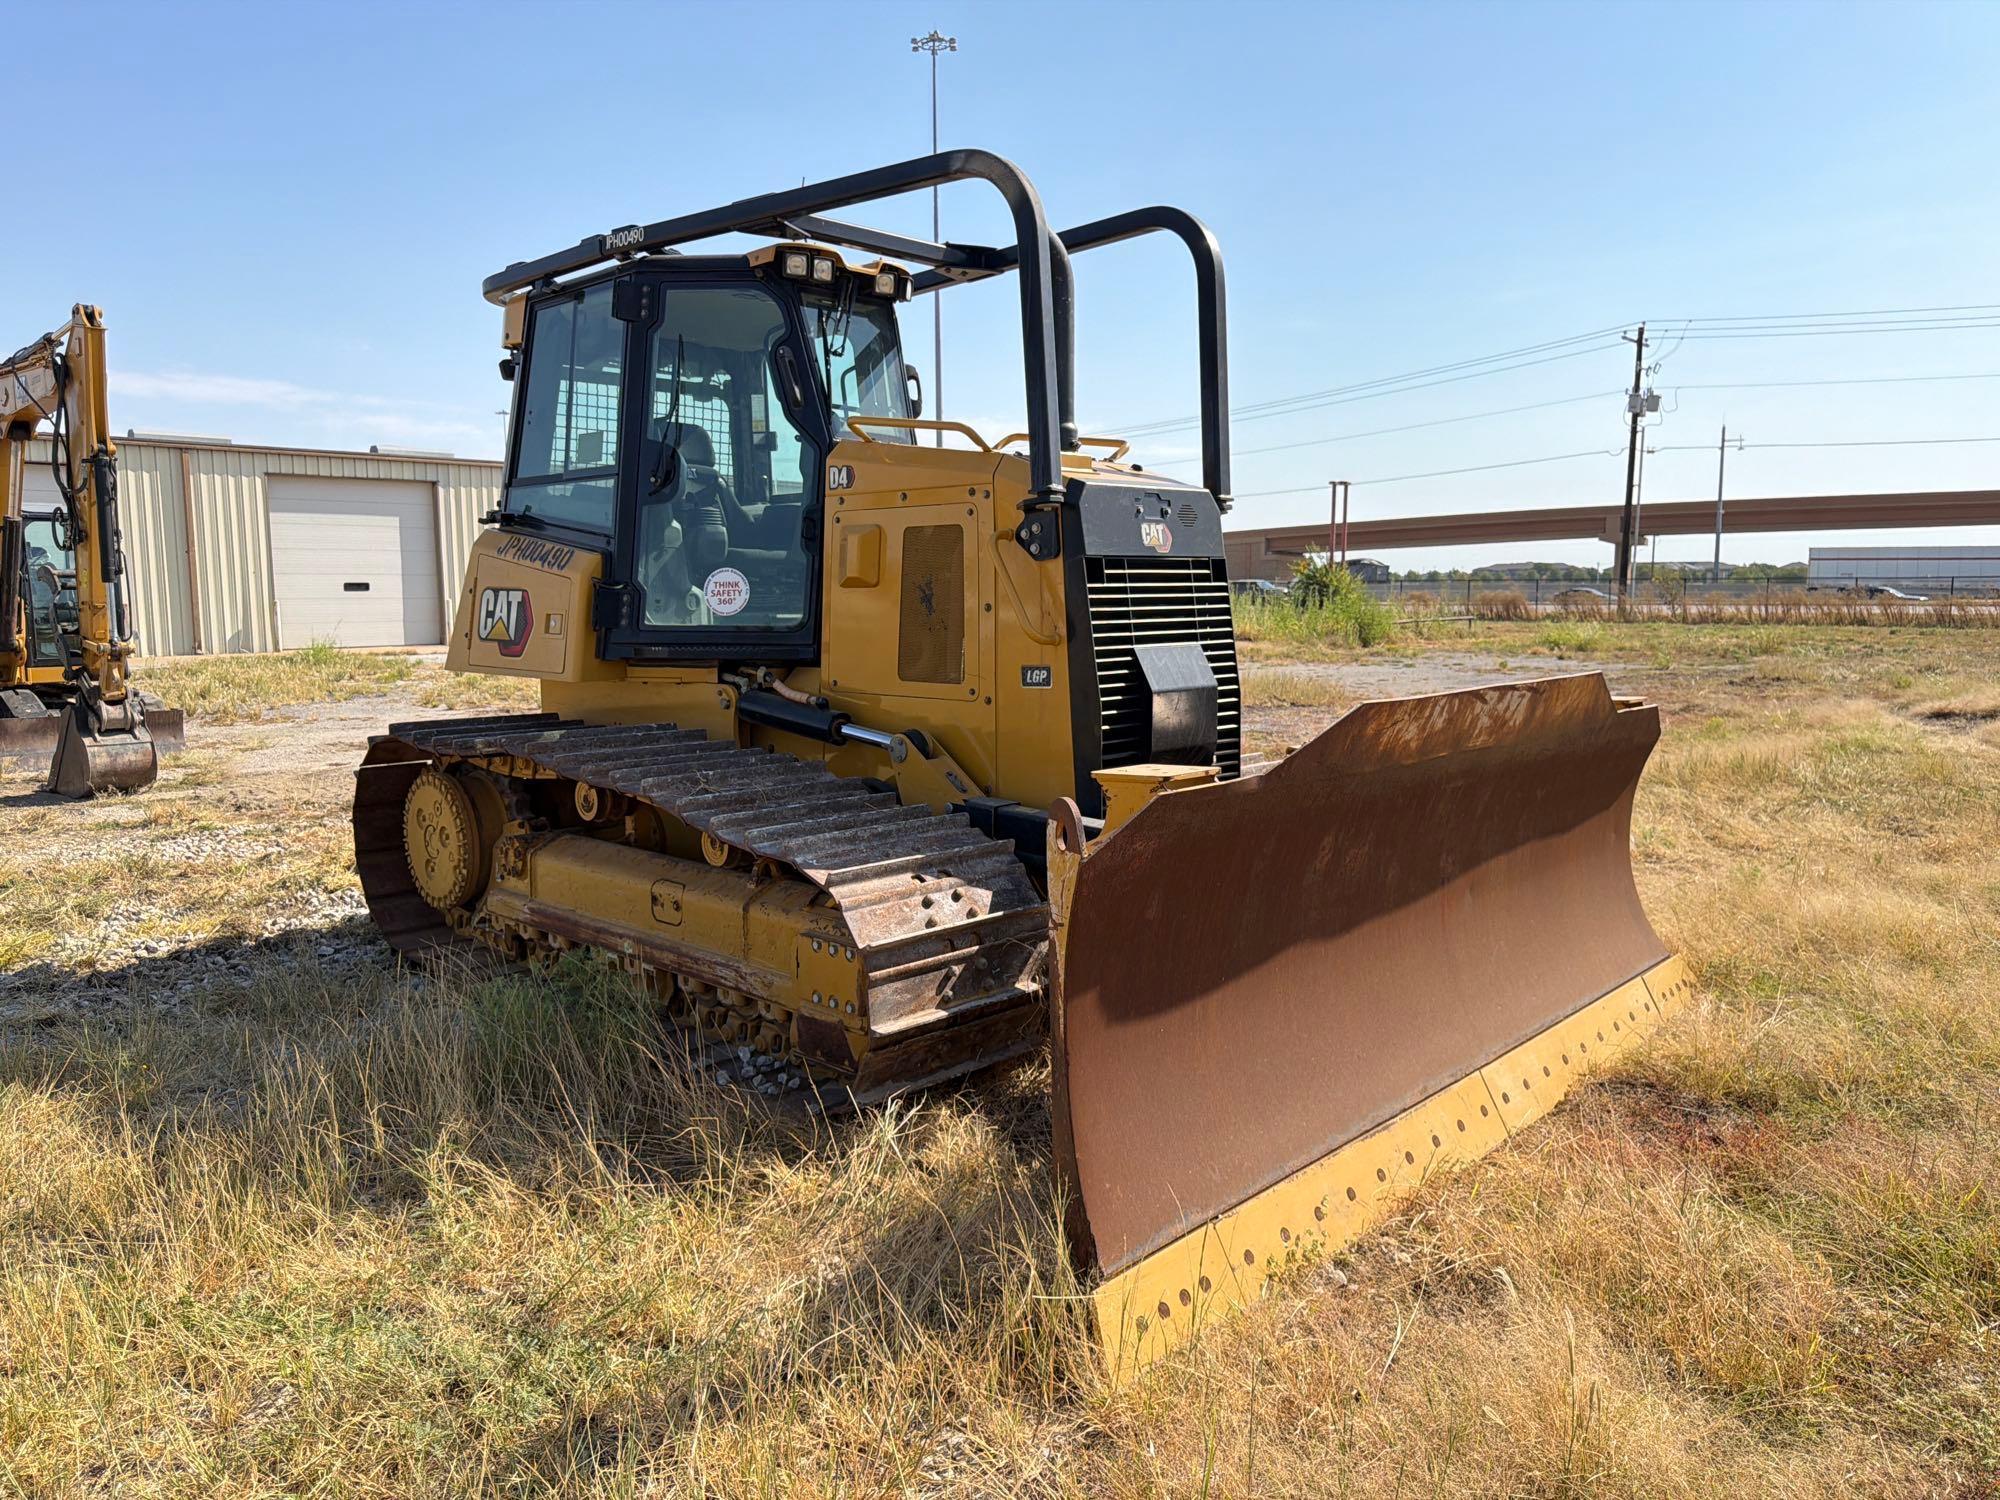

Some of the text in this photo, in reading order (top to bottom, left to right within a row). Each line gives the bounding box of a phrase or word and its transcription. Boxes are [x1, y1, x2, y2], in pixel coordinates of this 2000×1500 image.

[605, 227, 645, 250] JPH00490
[829, 466, 848, 489] D4
[1141, 522, 1165, 546] CAT
[496, 535, 575, 571] JPH00490
[710, 589, 743, 597] SAFETY
[713, 581, 741, 589] THINK
[479, 588, 523, 640] CAT
[1026, 670, 1048, 683] LGP
